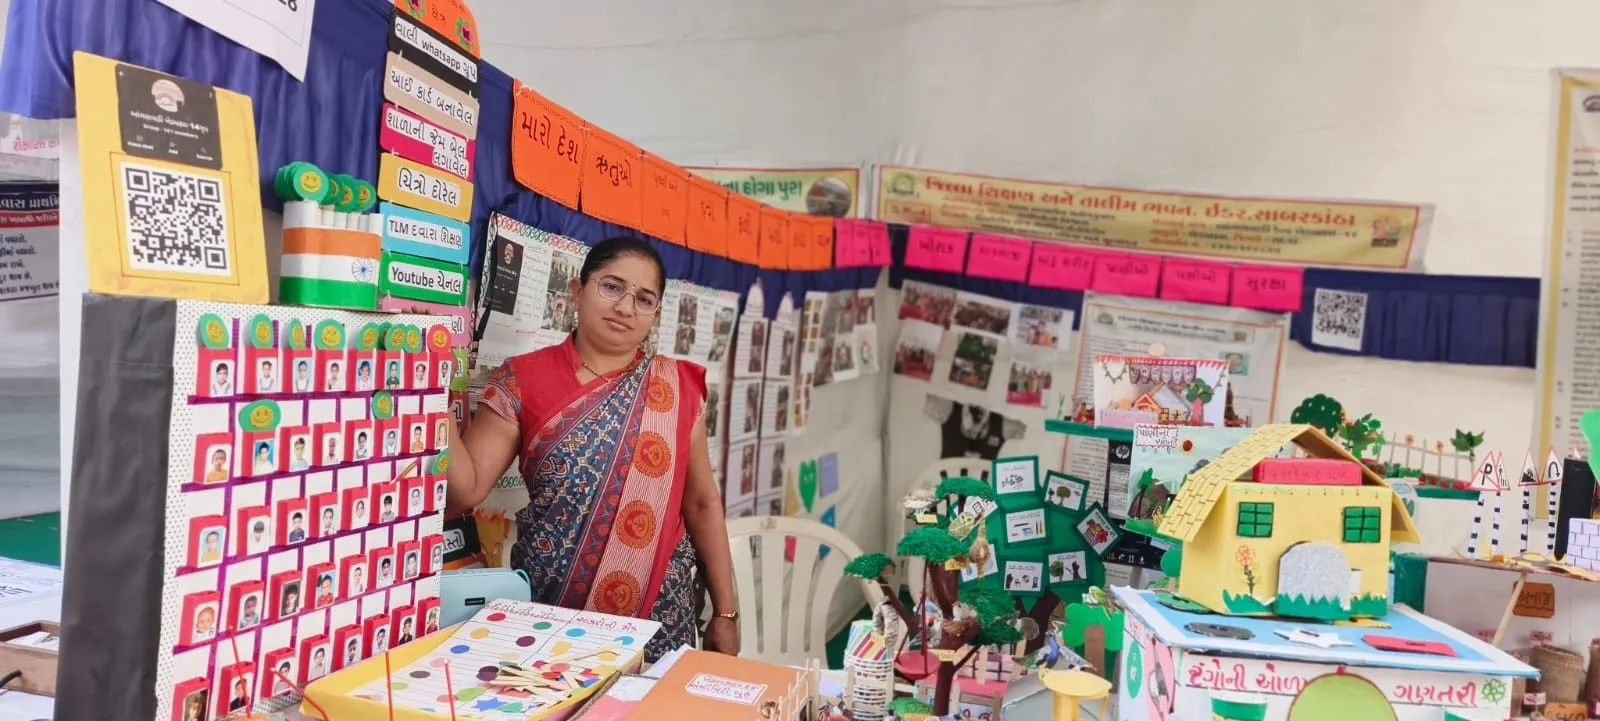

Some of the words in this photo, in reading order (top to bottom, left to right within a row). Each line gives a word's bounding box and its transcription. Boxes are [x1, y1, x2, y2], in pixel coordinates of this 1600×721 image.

[396, 22, 418, 45] વાલી
[421, 39, 461, 71] whatsapp
[417, 86, 432, 104] કાર્ડ
[436, 96, 473, 126] બનાવેલ
[387, 112, 425, 140] શાળાની
[429, 128, 446, 150] જેમ
[450, 137, 466, 159] બેલ
[522, 112, 551, 149] મારો
[557, 125, 578, 164] દેશ
[433, 151, 467, 177] લગાવેલ
[398, 167, 426, 196] ચિત્રો
[432, 179, 457, 206] દોરેલ
[743, 175, 775, 196] હોગા
[1041, 189, 1074, 206] અને
[1079, 194, 1137, 212] તાલીમ
[389, 219, 409, 234] TLM
[441, 226, 462, 248] શિક્ષણ
[391, 266, 434, 288] Youtube
[437, 270, 461, 293] ચેનલ
[1187, 658, 1247, 691] રંગોની
[1393, 681, 1477, 706] ગણતરી
